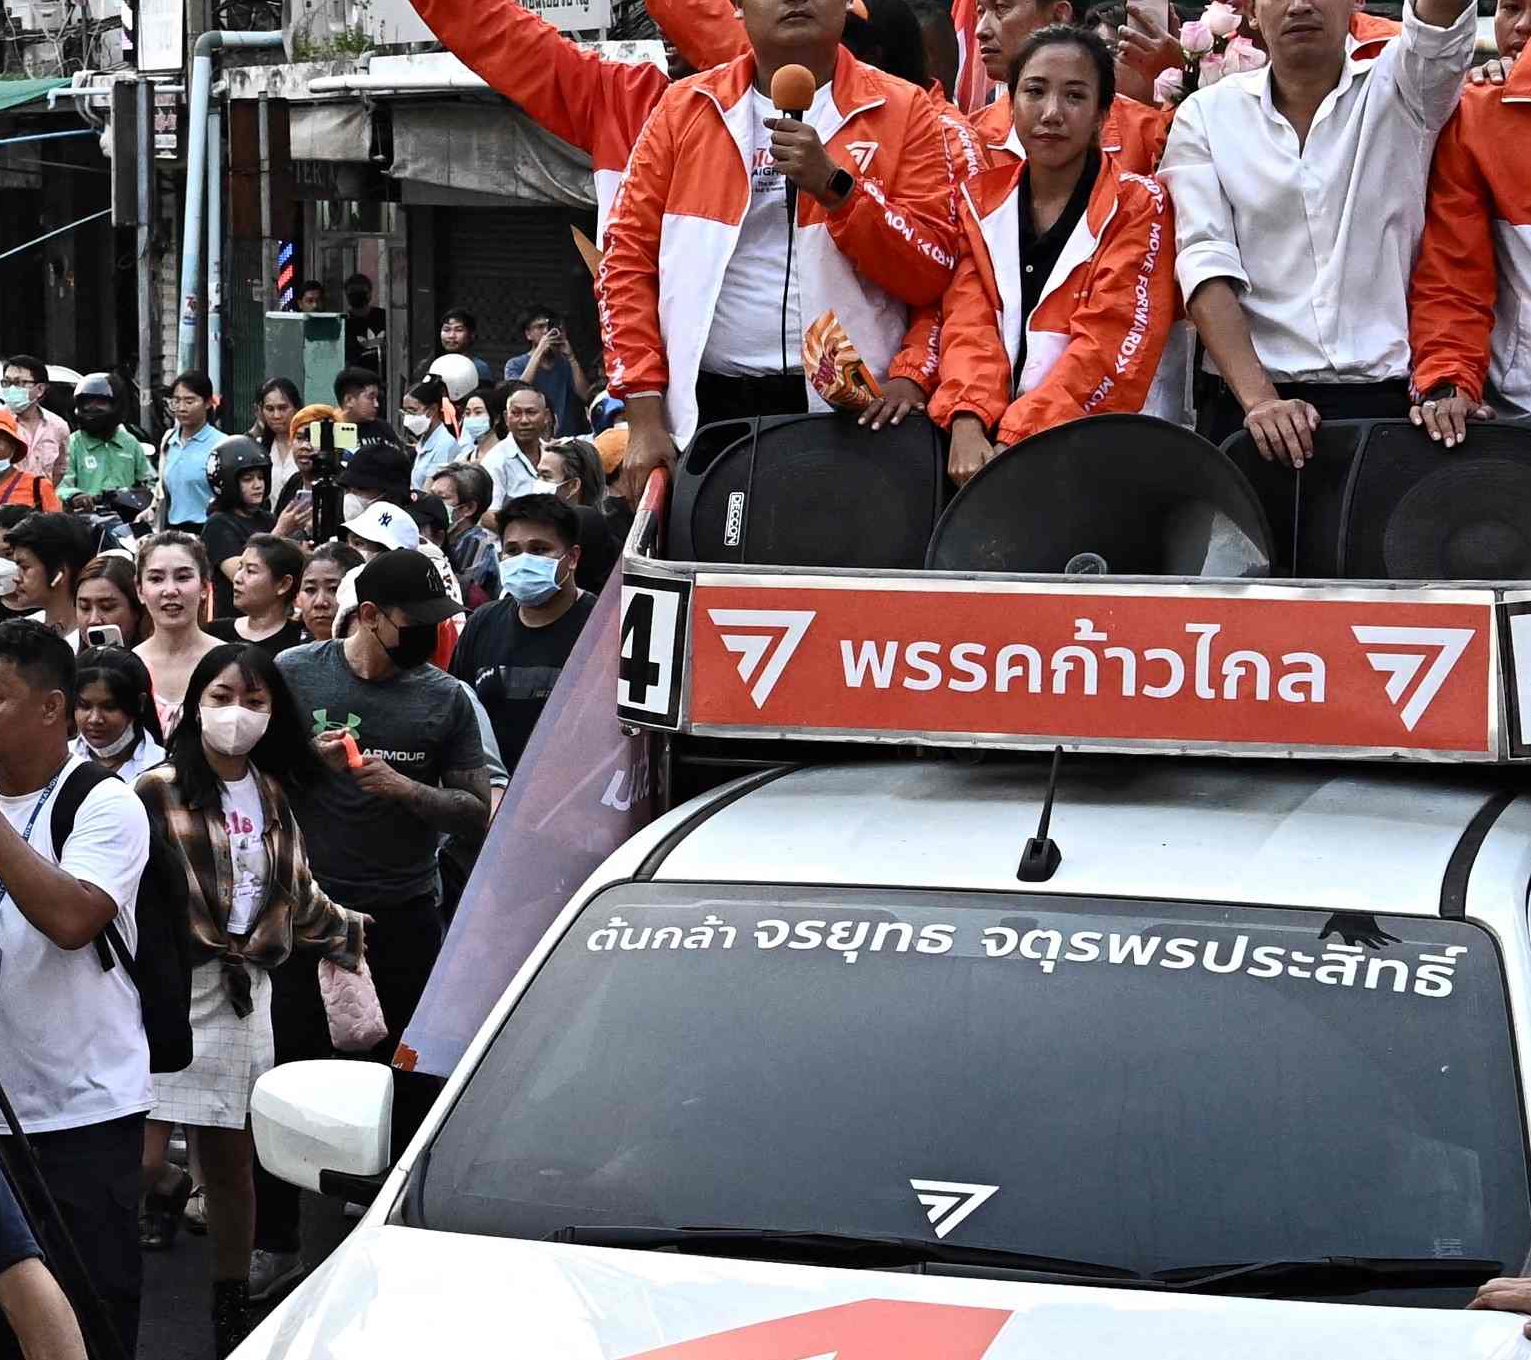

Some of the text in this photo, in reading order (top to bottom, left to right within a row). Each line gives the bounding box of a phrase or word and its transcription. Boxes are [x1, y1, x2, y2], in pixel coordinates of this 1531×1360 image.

[726, 494, 743, 544] DECCON
[620, 592, 660, 705] 4
[839, 618, 1328, 703] พรรคก้าวไกล
[361, 747, 426, 762] ARMOUR
[586, 913, 1469, 998] ต้นกล้า จรยุทธ จตุรพรประสิทธิ์
